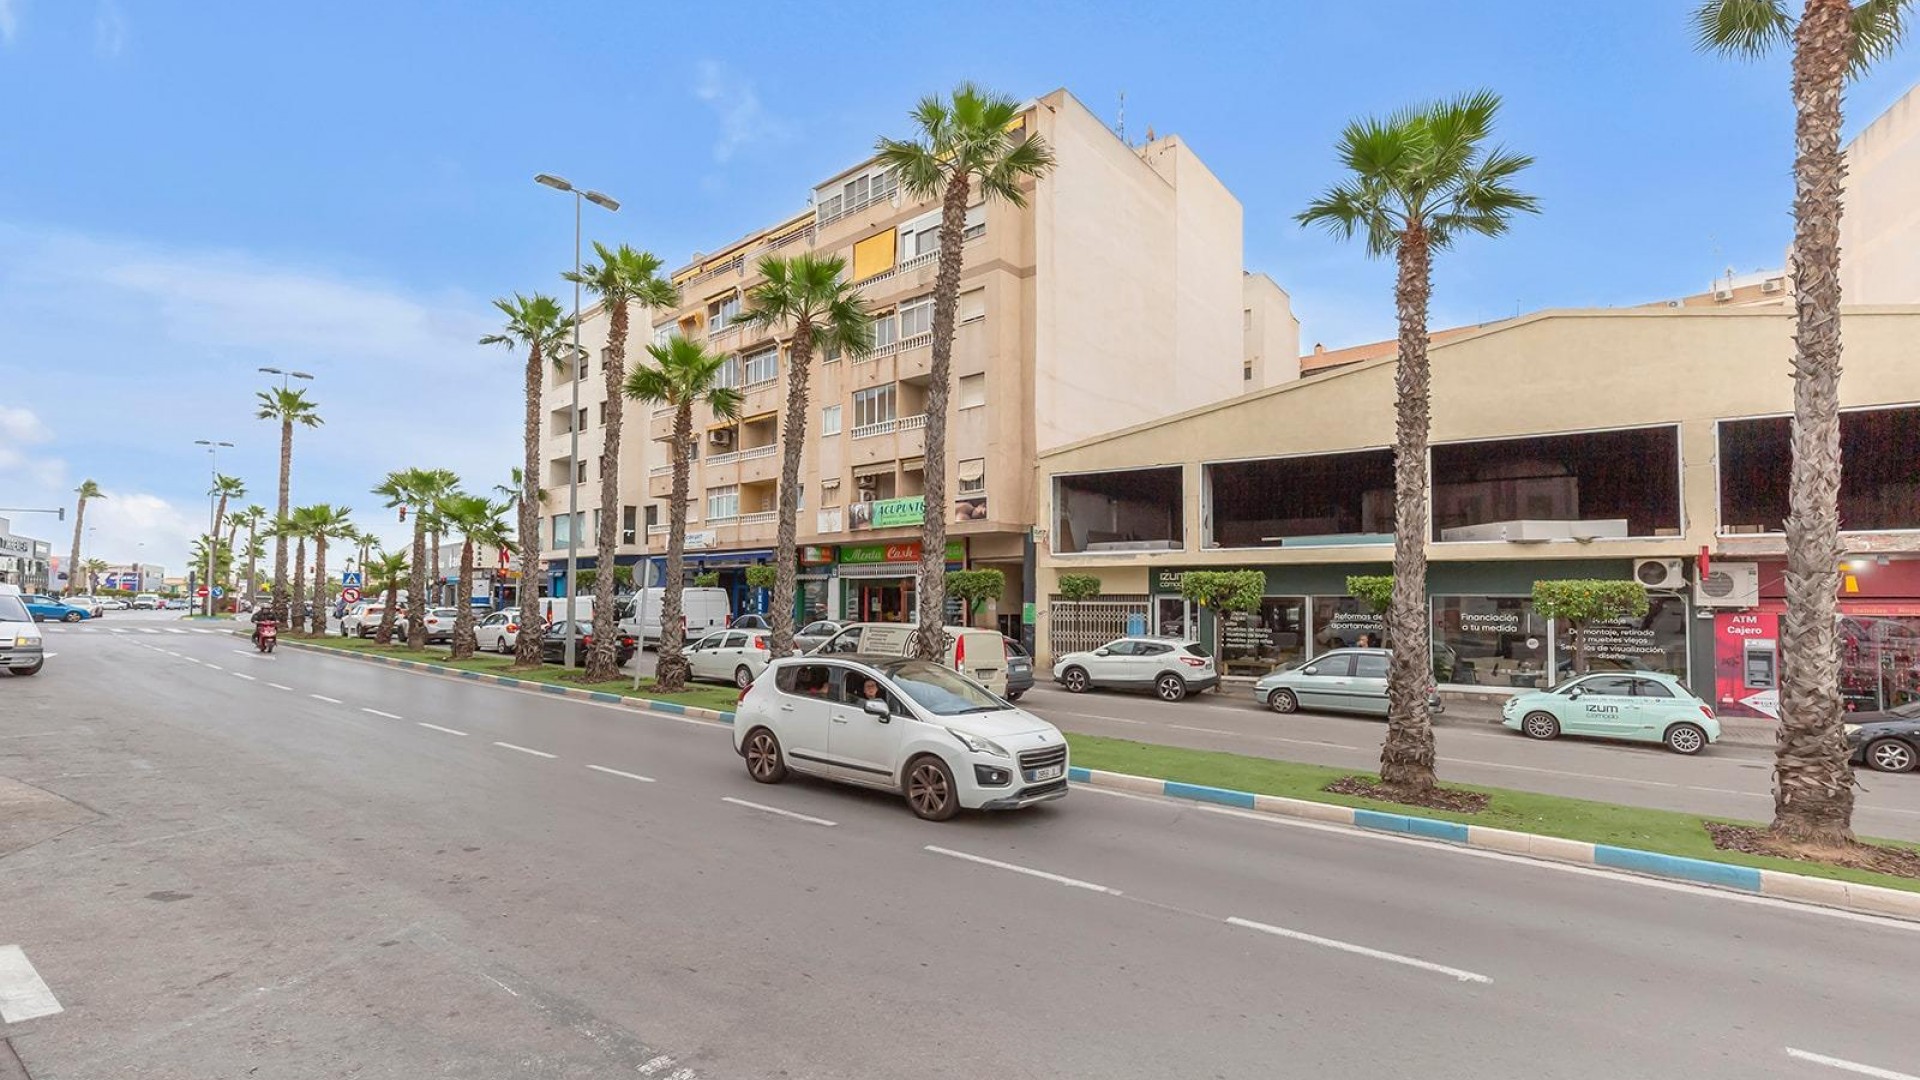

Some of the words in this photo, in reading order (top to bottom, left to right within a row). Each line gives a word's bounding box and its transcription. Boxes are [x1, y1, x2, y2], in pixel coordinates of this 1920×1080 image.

[880, 502, 925, 515] ACUPUNTU
[887, 546, 914, 559] Cash
[1334, 612, 1371, 621] Reformas
[1461, 612, 1519, 622] Financiación
[1732, 615, 1758, 623] ATM
[1331, 622, 1384, 630] apartamento
[1481, 624, 1518, 633] medida
[1620, 628, 1655, 636] retirada
[1727, 626, 1763, 636] Cajero
[1588, 636, 1622, 644] muebles
[1597, 644, 1609, 652] de
[1598, 652, 1626, 660] diseño
